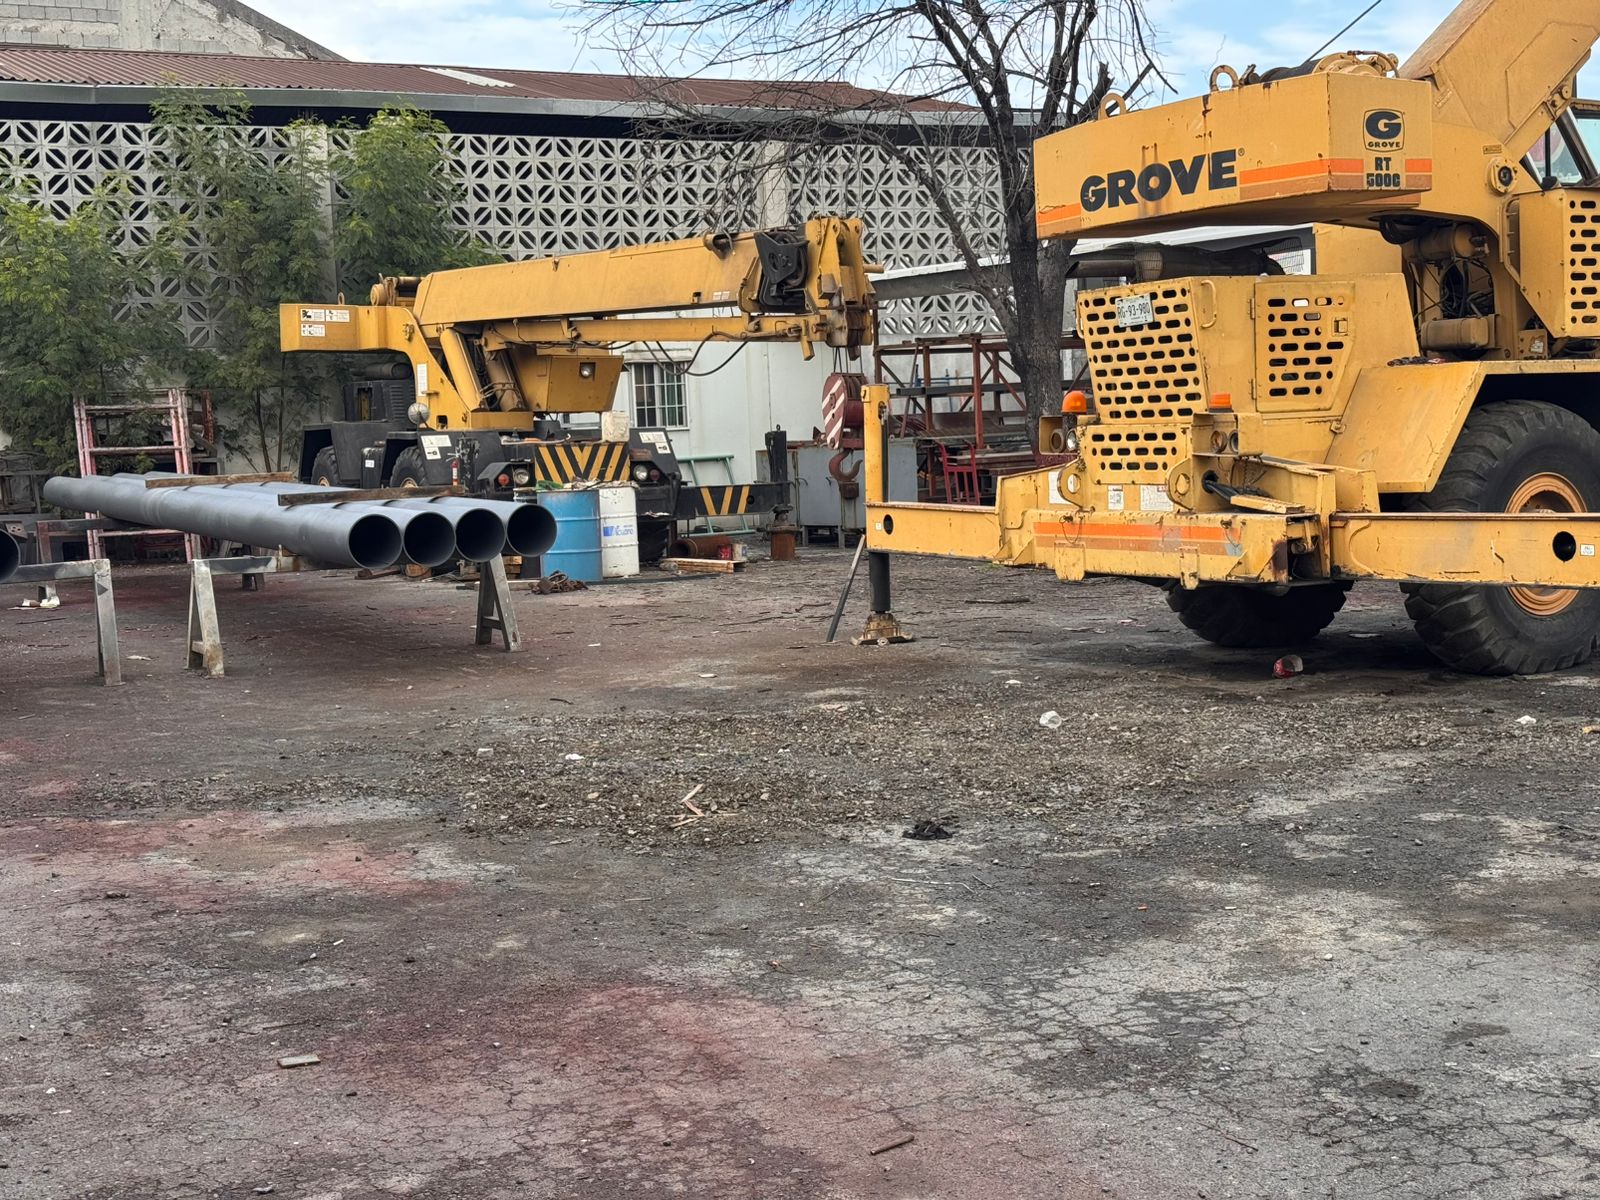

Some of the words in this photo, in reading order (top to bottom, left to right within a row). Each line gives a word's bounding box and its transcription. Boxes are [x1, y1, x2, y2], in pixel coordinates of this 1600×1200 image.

[1374, 156, 1392, 171] RT
[1080, 148, 1238, 212] GROVE
[1366, 173, 1401, 188] 500C
